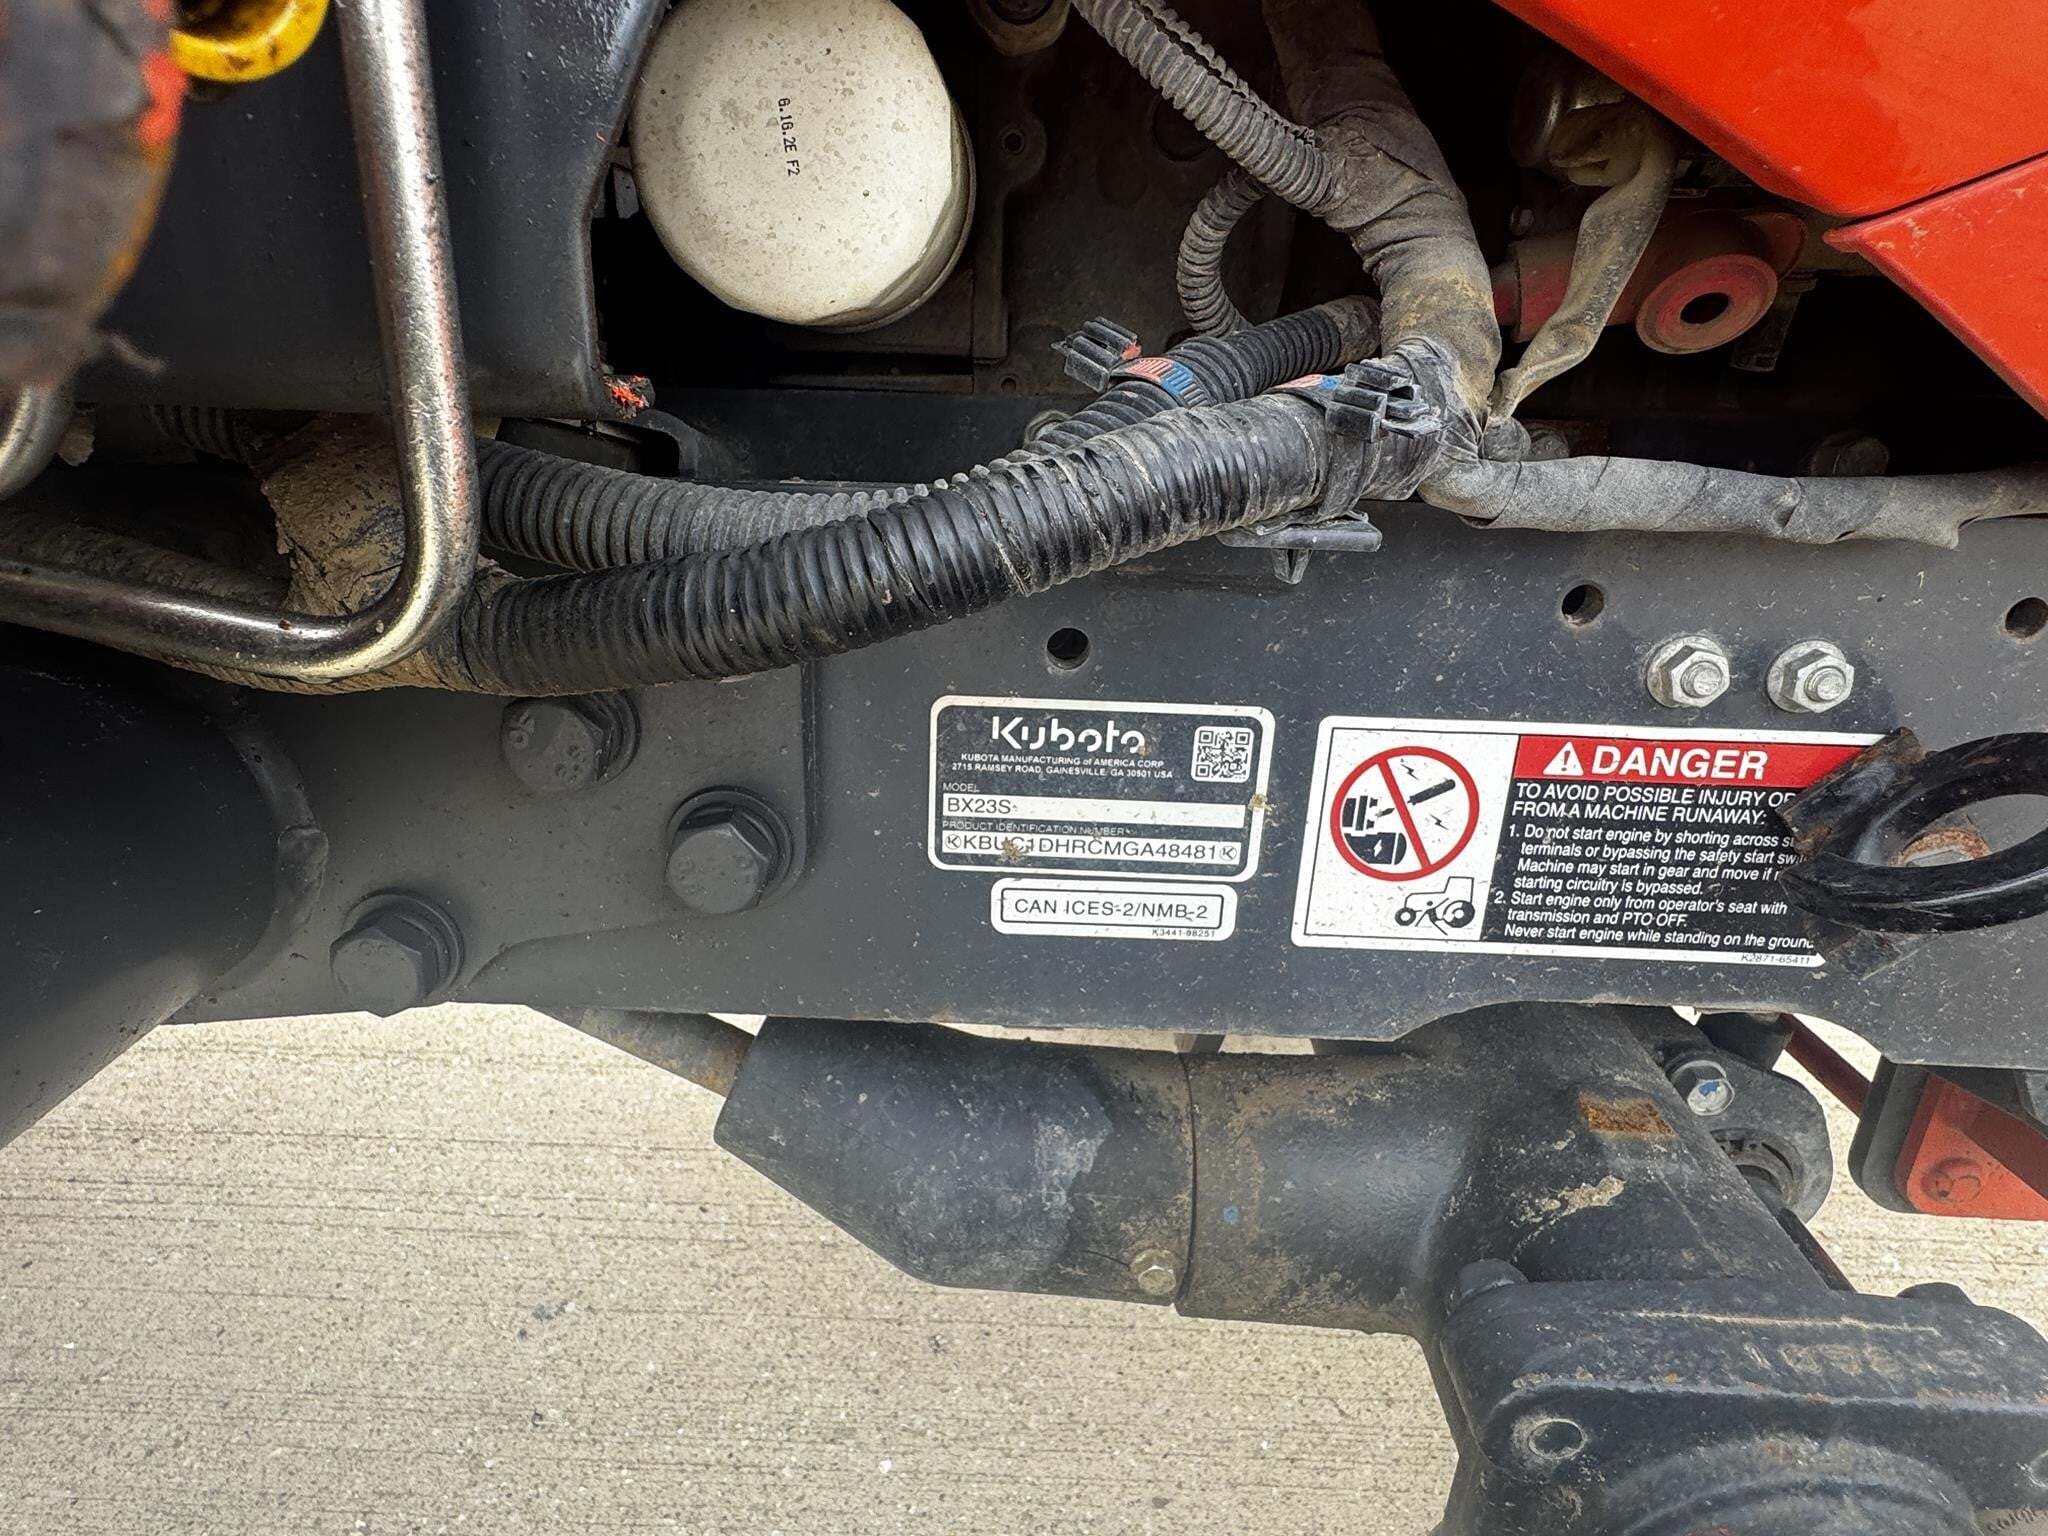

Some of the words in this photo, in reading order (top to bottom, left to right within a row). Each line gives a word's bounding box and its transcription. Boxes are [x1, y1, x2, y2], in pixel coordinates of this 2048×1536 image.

[786, 159, 800, 177] F2
[991, 715, 1145, 754] Kubota
[952, 763, 973, 771] 2715
[974, 763, 1013, 773] RAMSEY
[1111, 769, 1124, 777] GA
[1153, 770, 1173, 779] USA
[961, 753, 999, 762] KUBOTA
[1001, 755, 1080, 766] MANUFACTURING
[1082, 758, 1092, 766] of
[1093, 758, 1135, 768] AMERICA
[1591, 744, 1769, 781] DANGER
[942, 782, 981, 793] MODEL
[1516, 782, 1541, 800] TO
[1543, 783, 1600, 802] AVOID
[1603, 785, 1695, 804] POSSIBLE
[1698, 788, 1766, 807] INJURY
[947, 797, 1011, 814] BX23S
[1511, 801, 1565, 818] FROM
[1568, 802, 1580, 818] A
[1583, 803, 1668, 822] MACHINE
[1671, 806, 1768, 825] RUNAWAY:
[942, 820, 993, 831] PRODUCT
[995, 822, 1077, 834] IDENTIFICATION
[1079, 826, 1124, 836] NUMBER
[1509, 823, 1520, 838] 1.
[1524, 823, 1544, 839] Do
[1547, 826, 1570, 839] not
[1571, 826, 1603, 840] start
[1605, 827, 1652, 845] engine
[1654, 828, 1672, 844] by
[1674, 829, 1730, 848] shorting
[1733, 835, 1779, 848] across
[1520, 842, 1582, 857] terminals
[1584, 846, 1600, 857] or
[1602, 843, 1671, 863] bypassing
[1674, 847, 1696, 861] the
[1699, 848, 1742, 866] safety
[1743, 849, 1776, 864] start
[1517, 857, 1574, 874] Machine
[1577, 862, 1607, 878] may
[1609, 862, 1640, 876] start
[1642, 862, 1655, 876] in
[1657, 865, 1688, 880] gear
[1691, 864, 1718, 879] and
[1721, 867, 1759, 881] move
[1761, 867, 1774, 881] if
[1513, 876, 1563, 893] starting
[1566, 877, 1619, 893] circuitry
[1621, 878, 1633, 892] is
[1635, 879, 1704, 896] bypassed.
[1014, 898, 1057, 914] CAN
[1065, 899, 1208, 919] ICES-2/NMB-2
[1493, 890, 1507, 904] 2.
[1510, 890, 1543, 905] Start
[1545, 894, 1590, 910] engine
[1593, 895, 1622, 911] only
[1624, 896, 1655, 909] from
[1658, 899, 1725, 913] operator's
[1727, 901, 1759, 914] seat
[1760, 901, 1788, 915] with
[1507, 908, 1590, 925] transmission
[1593, 910, 1619, 925] and
[1622, 911, 1654, 926] PTO
[1655, 912, 1688, 928] OFF.
[1503, 924, 1545, 938] Never
[1546, 924, 1577, 939] start
[1578, 927, 1623, 943] engine
[1626, 929, 1661, 943] while
[1664, 931, 1721, 948] standing
[1723, 934, 1741, 947] on
[1744, 933, 1765, 947] the
